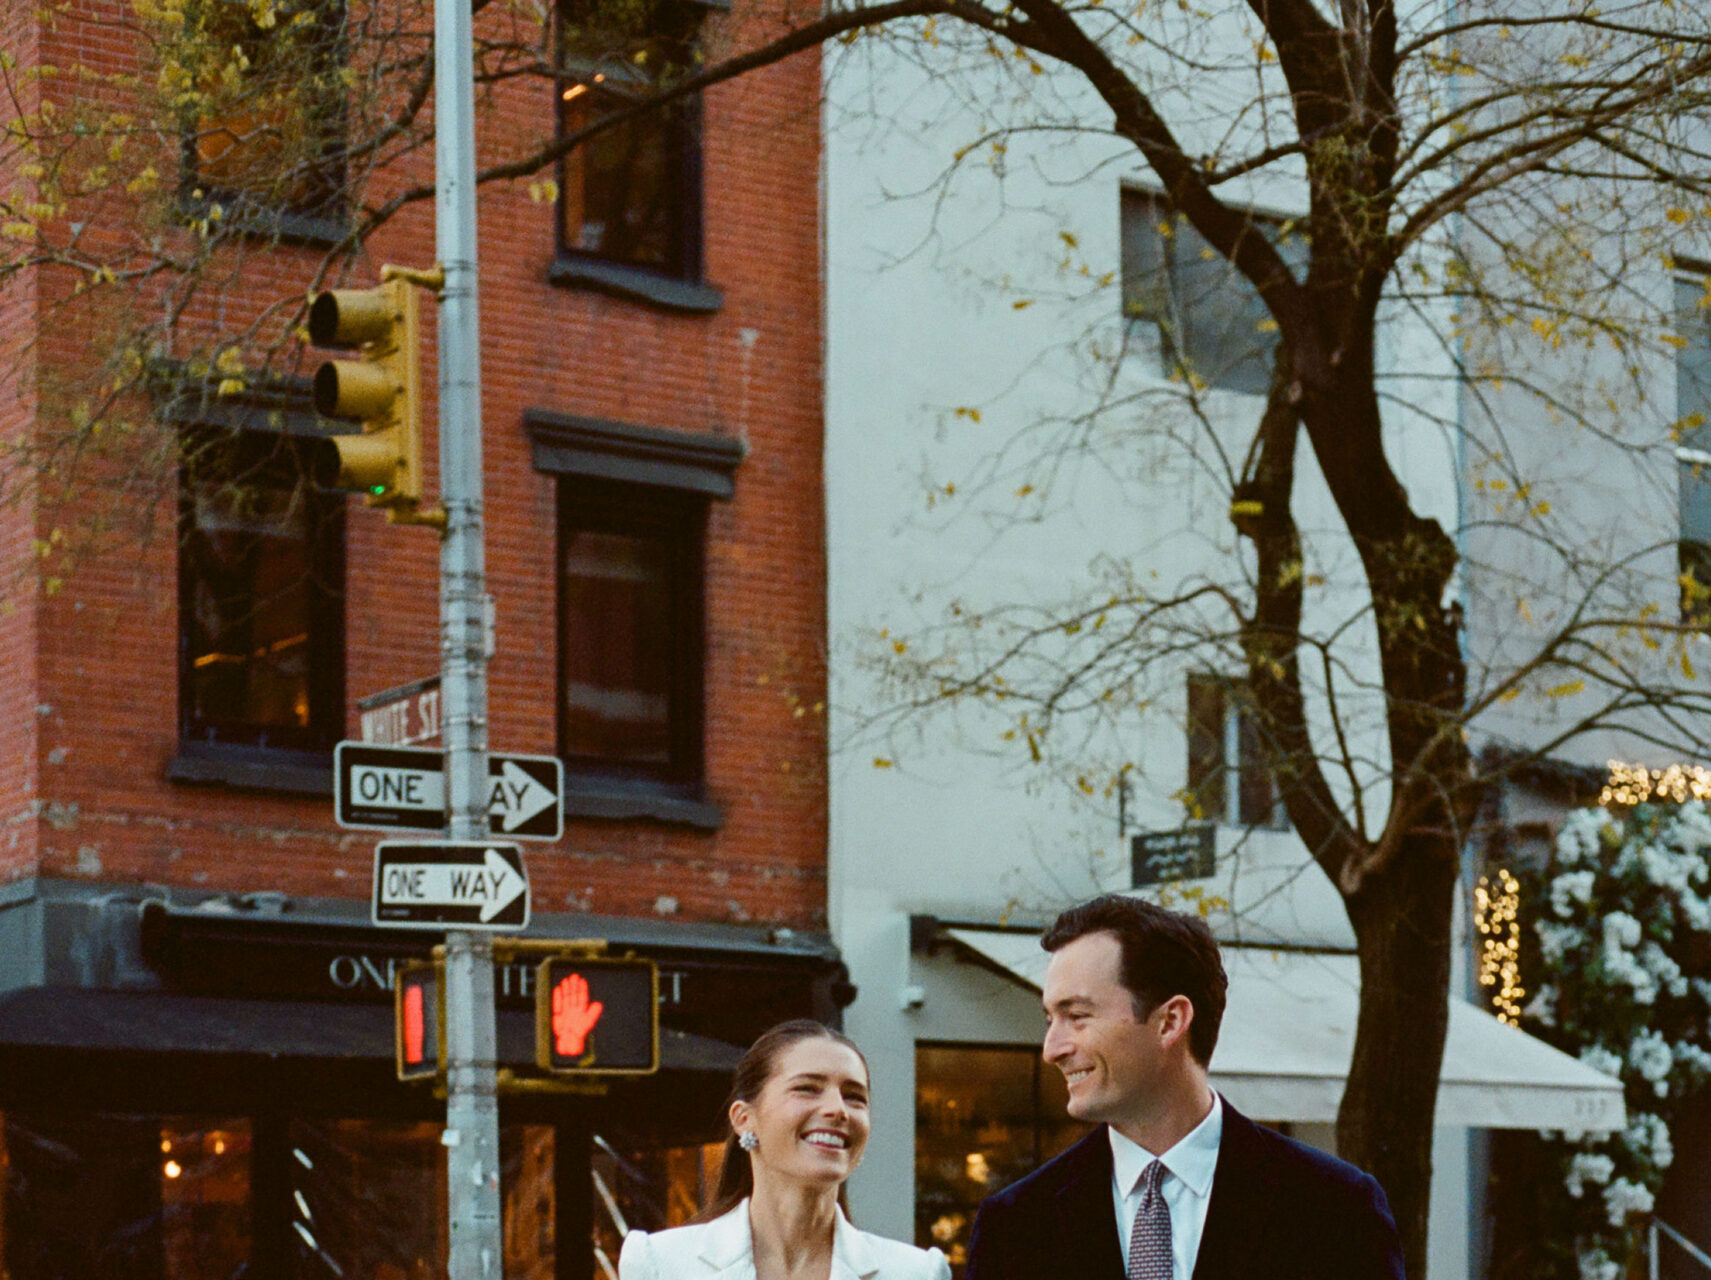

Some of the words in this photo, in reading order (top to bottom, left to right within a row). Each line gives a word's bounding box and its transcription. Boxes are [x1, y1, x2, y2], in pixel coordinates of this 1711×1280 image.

[359, 771, 424, 804] ONE
[487, 781, 530, 811] AY
[388, 869, 426, 898] ONE
[451, 871, 506, 900] WAY
